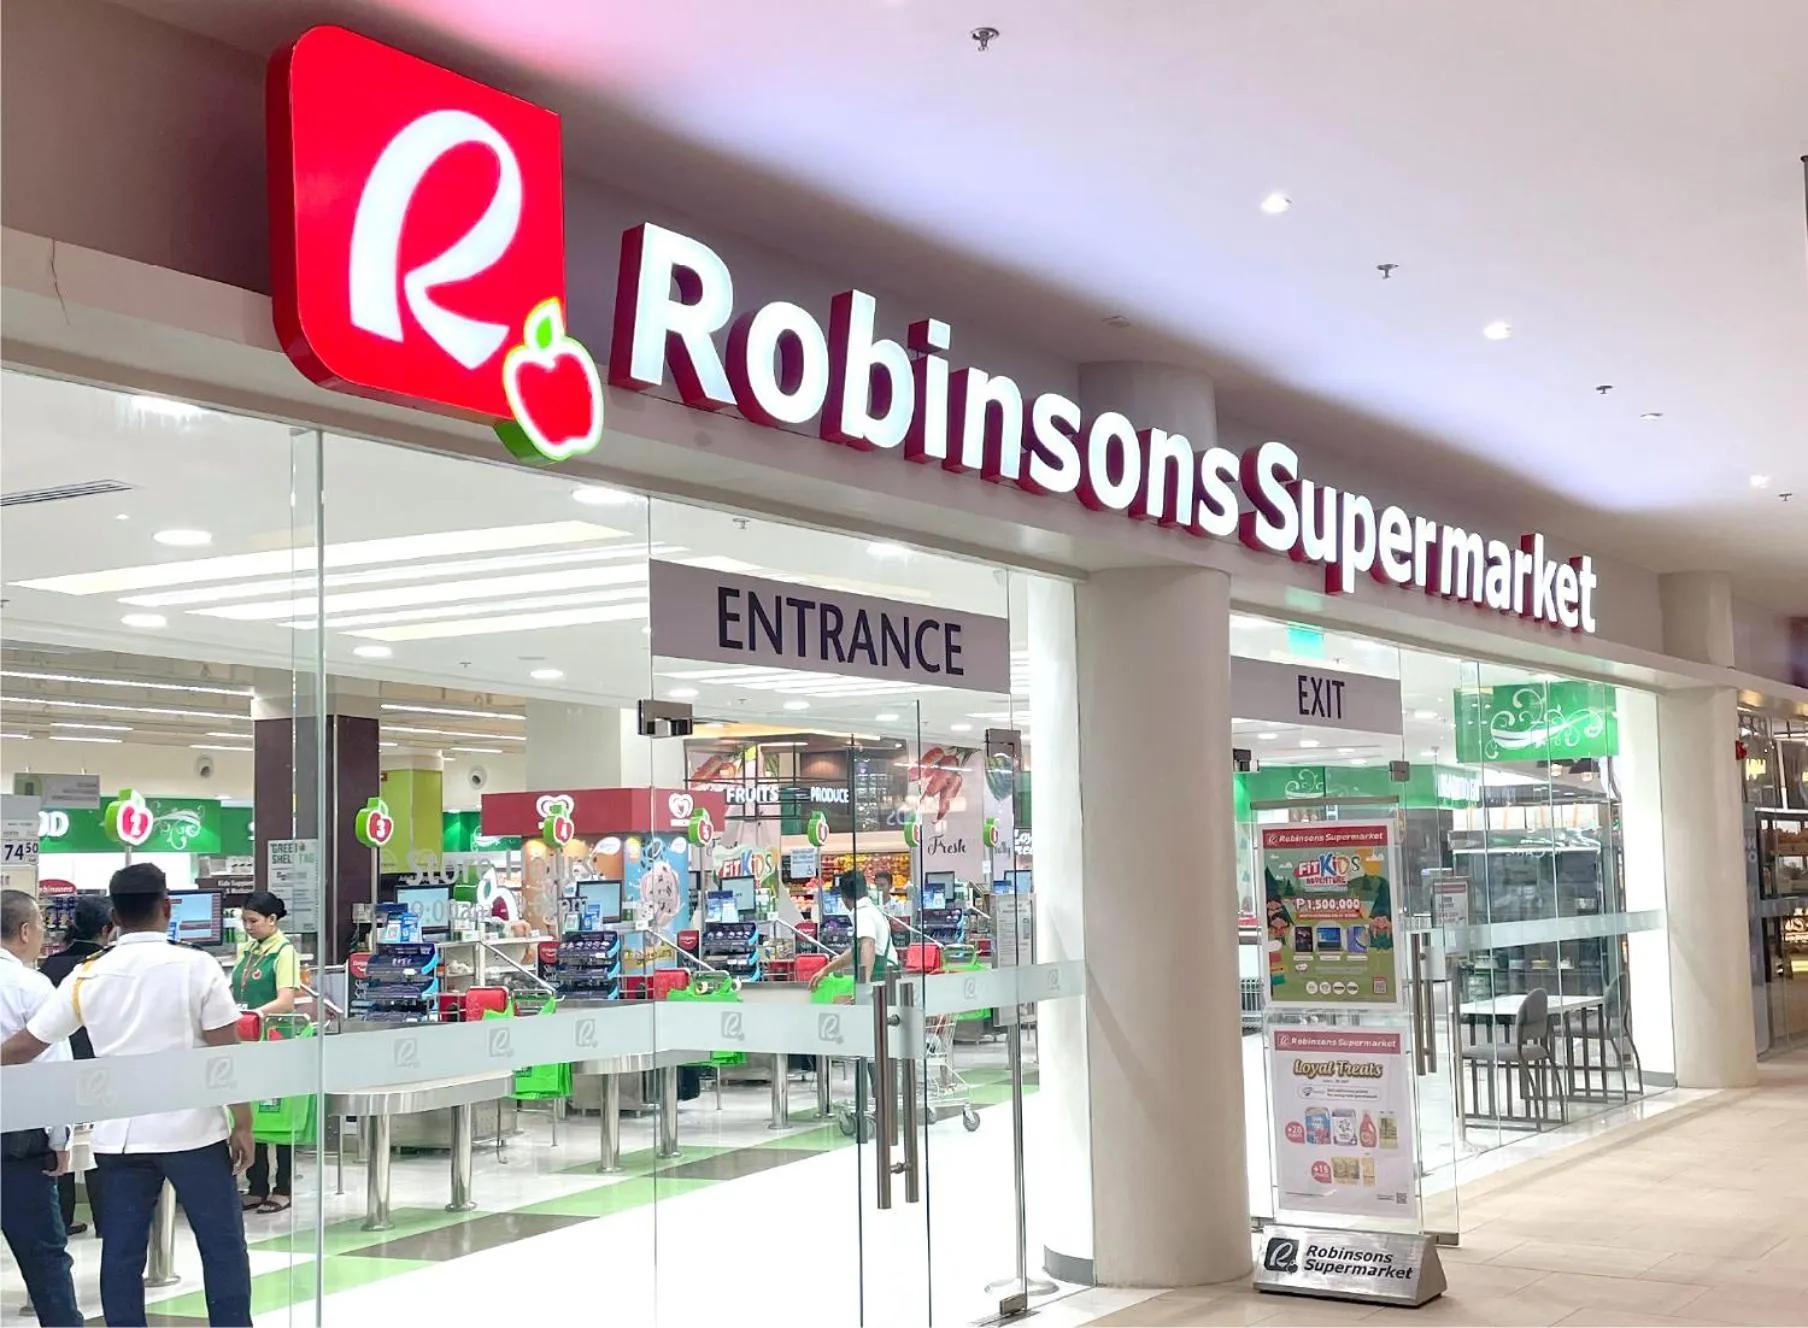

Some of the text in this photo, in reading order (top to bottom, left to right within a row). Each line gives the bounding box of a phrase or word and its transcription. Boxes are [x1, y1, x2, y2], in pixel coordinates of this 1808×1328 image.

[626, 222, 1598, 633] Robinsons Supermarket
[717, 585, 965, 677] ENTRANCE
[1298, 673, 1346, 721] EXIT
[726, 786, 850, 804] FRUITS PRODUCE
[927, 834, 967, 856] Fresh
[1325, 832, 1384, 844] Supermarket
[4, 844, 24, 861] 74
[406, 848, 493, 886] Store
[1293, 1058, 1383, 1079] Loyal Treats
[1306, 1245, 1394, 1264] Robinsons
[1303, 1258, 1414, 1280] Supermarket
